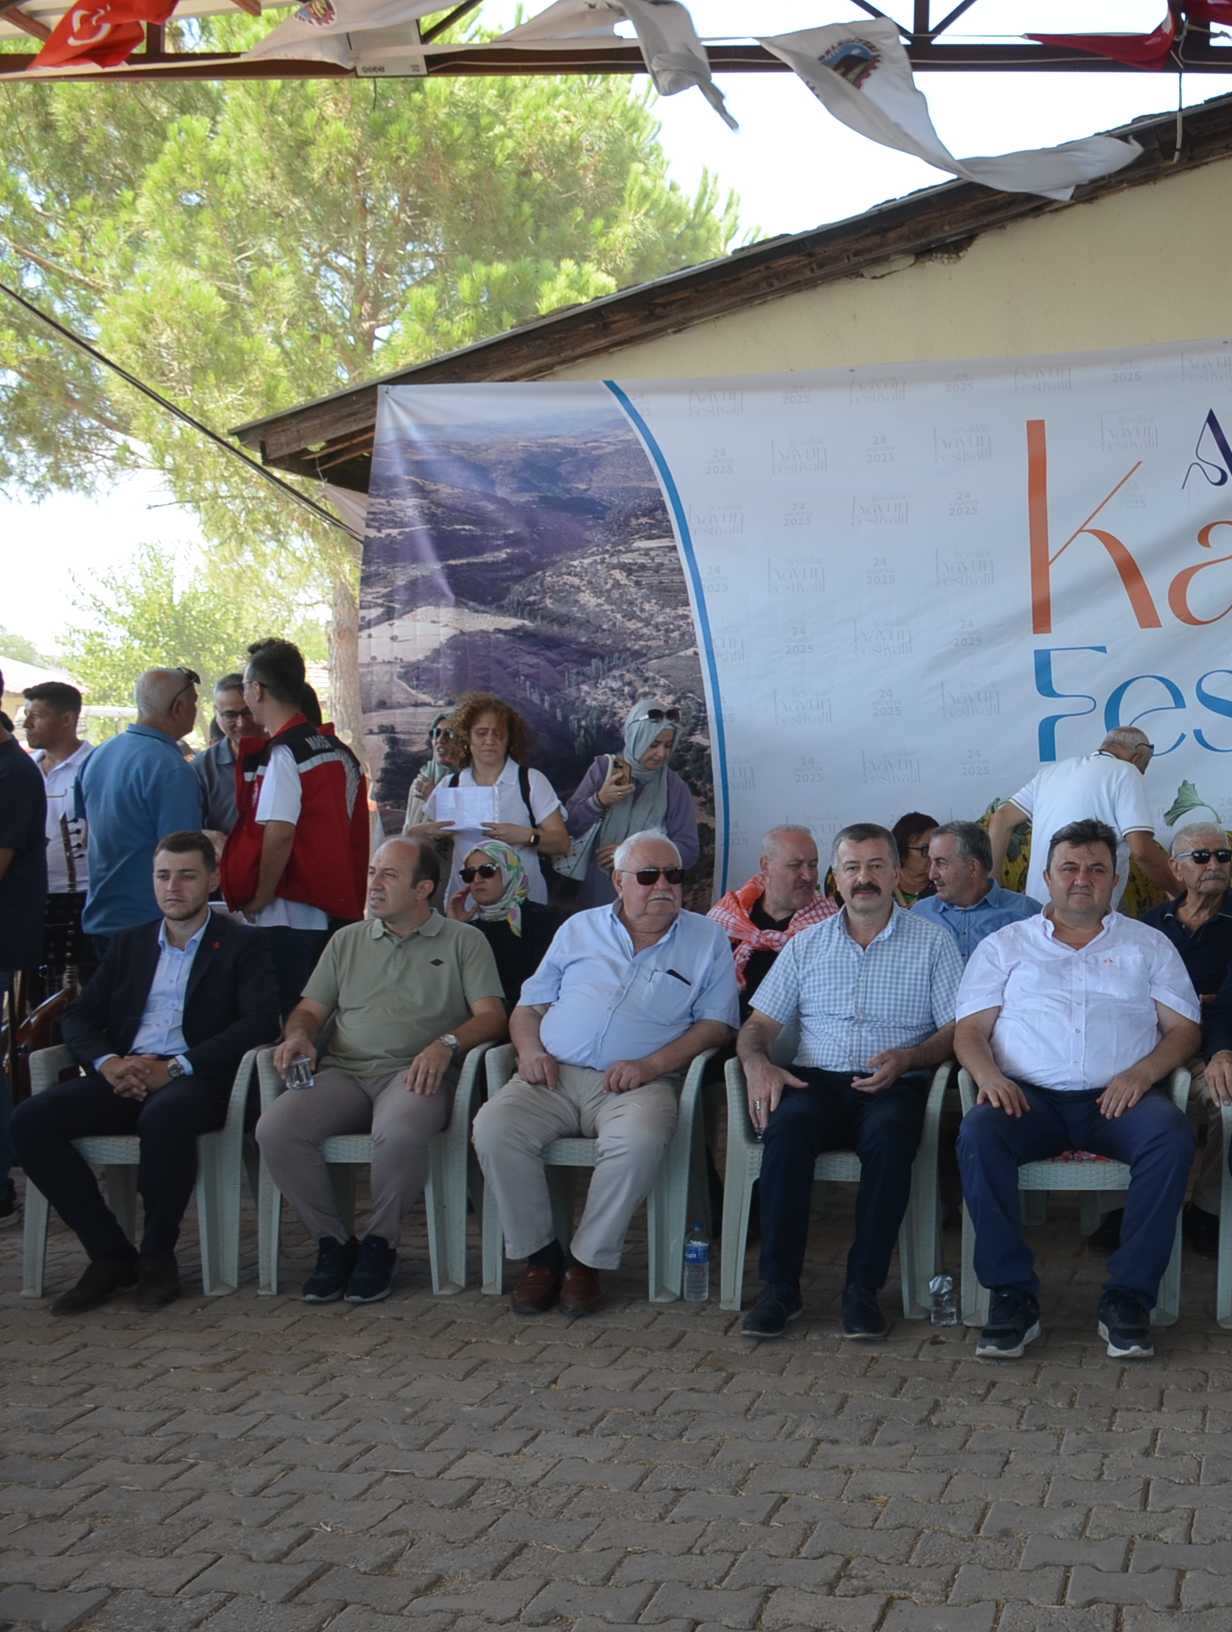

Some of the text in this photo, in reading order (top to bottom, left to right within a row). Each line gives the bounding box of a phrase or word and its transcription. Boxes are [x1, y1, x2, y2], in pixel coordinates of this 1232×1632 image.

[1112, 371, 1142, 382] 2025
[945, 382, 974, 393] 2025
[782, 394, 810, 405] 2025
[873, 435, 886, 445] 24
[712, 449, 725, 458] 24
[867, 453, 894, 463] 2025
[706, 465, 734, 474] 2025
[956, 491, 970, 500] 24
[790, 501, 804, 510] 24
[949, 507, 978, 516] 2025
[783, 517, 812, 526] 2025
[873, 557, 887, 567] 24
[866, 575, 895, 585] 2025
[960, 619, 974, 629] 24
[792, 626, 806, 636] 24
[953, 637, 982, 647] 2025
[785, 644, 814, 655] 2025
[879, 689, 893, 699] 24
[872, 707, 901, 717] 2025
[968, 749, 981, 758] 24
[801, 757, 815, 766] 24
[961, 766, 990, 776] 2025
[794, 773, 823, 783] 2025
